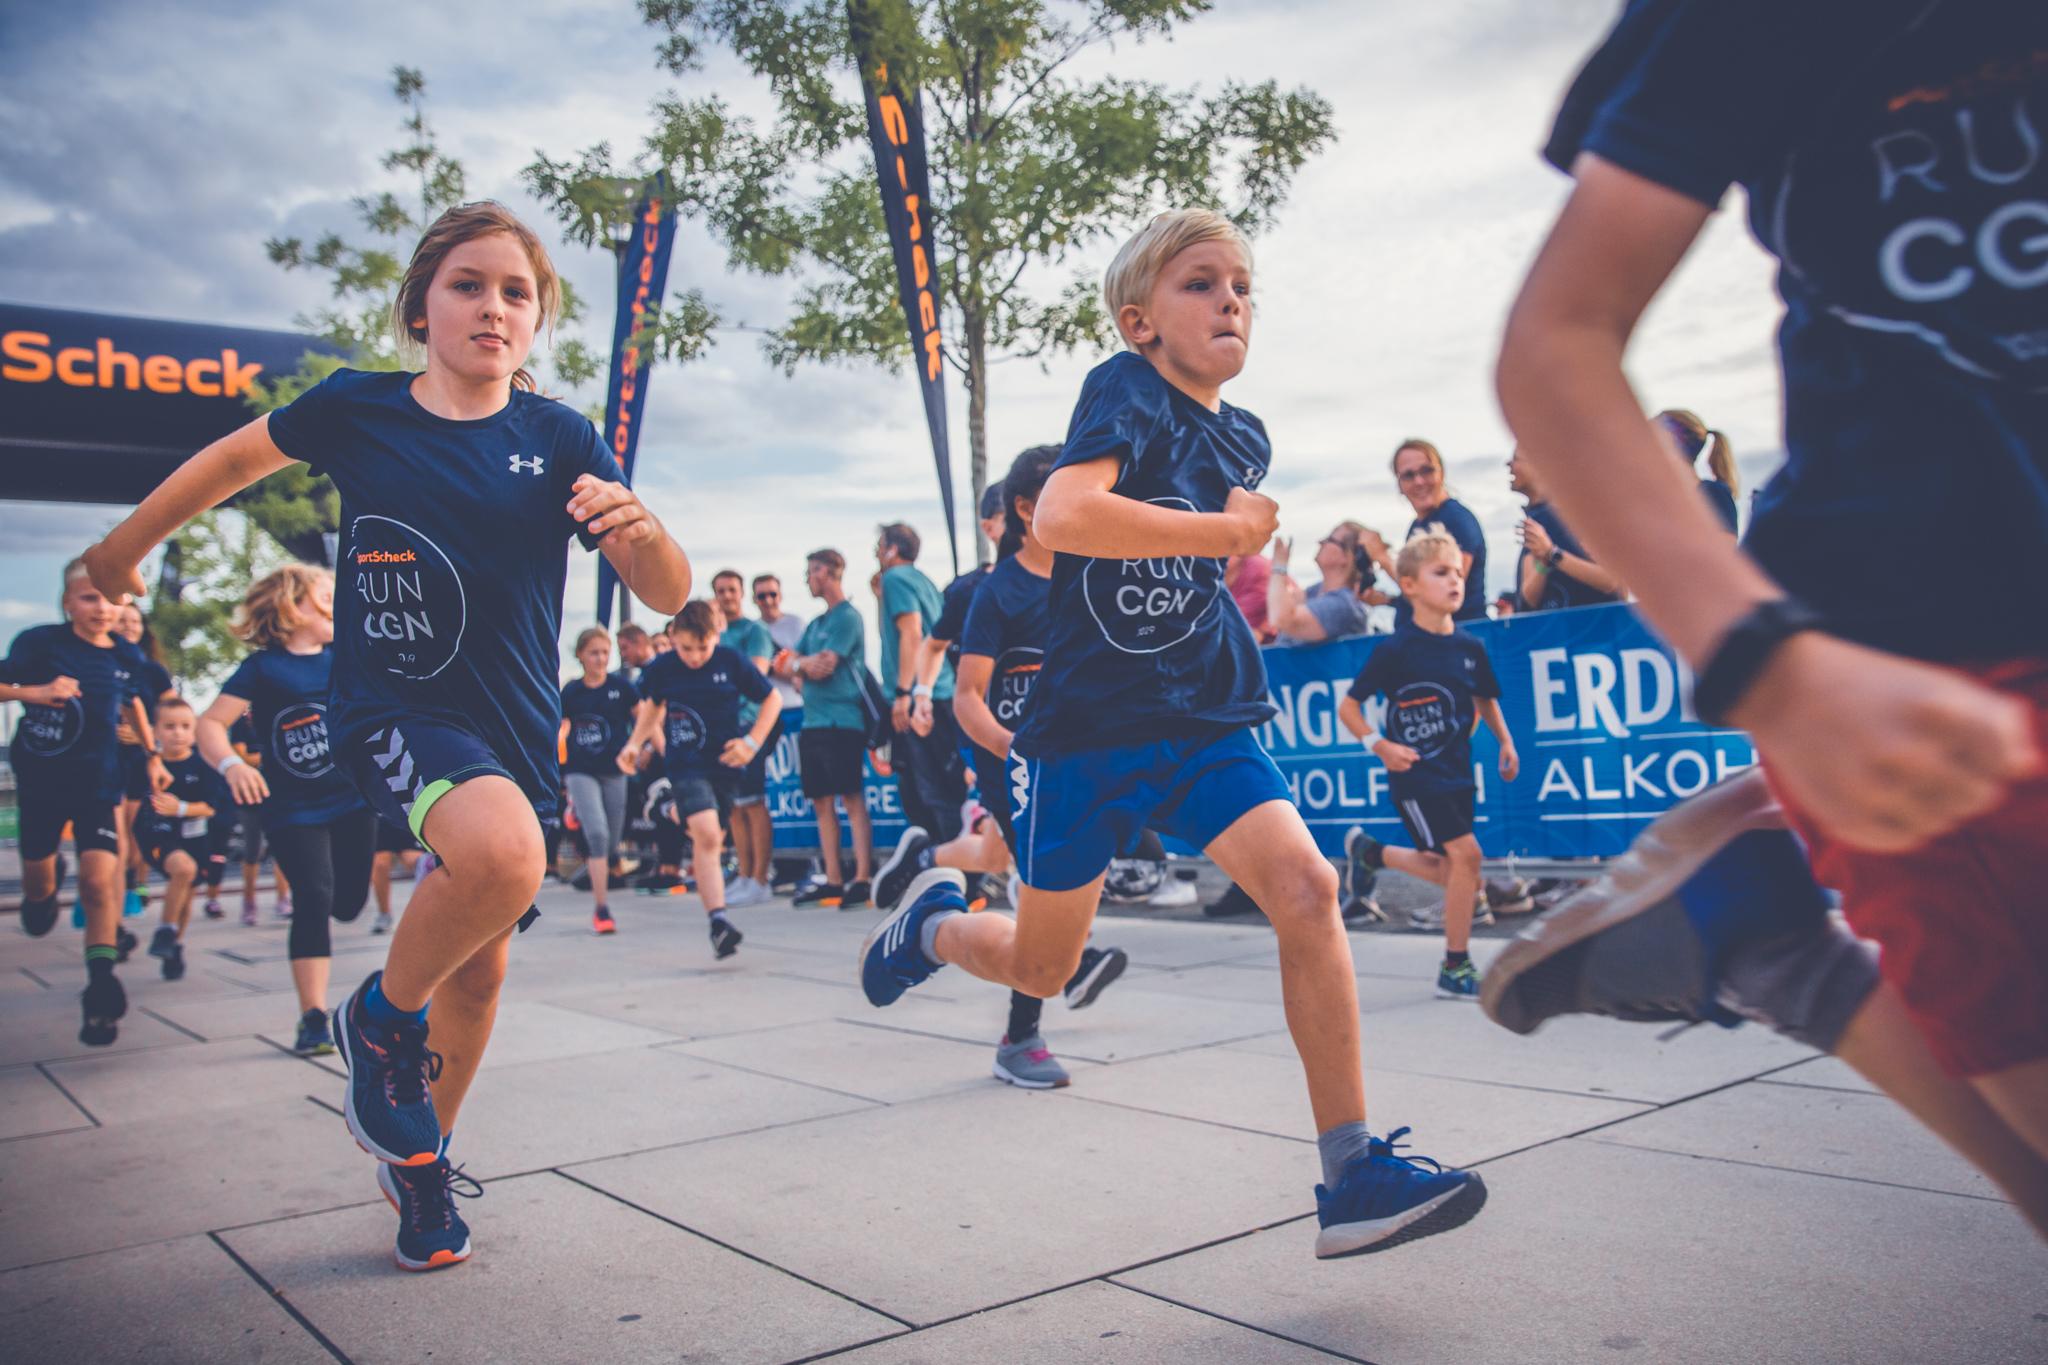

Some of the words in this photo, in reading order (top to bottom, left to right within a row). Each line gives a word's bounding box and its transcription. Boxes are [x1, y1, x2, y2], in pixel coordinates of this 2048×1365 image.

[1, 330, 263, 398] Scheck
[1116, 584, 1195, 617] CGN
[284, 720, 329, 749] RUN
